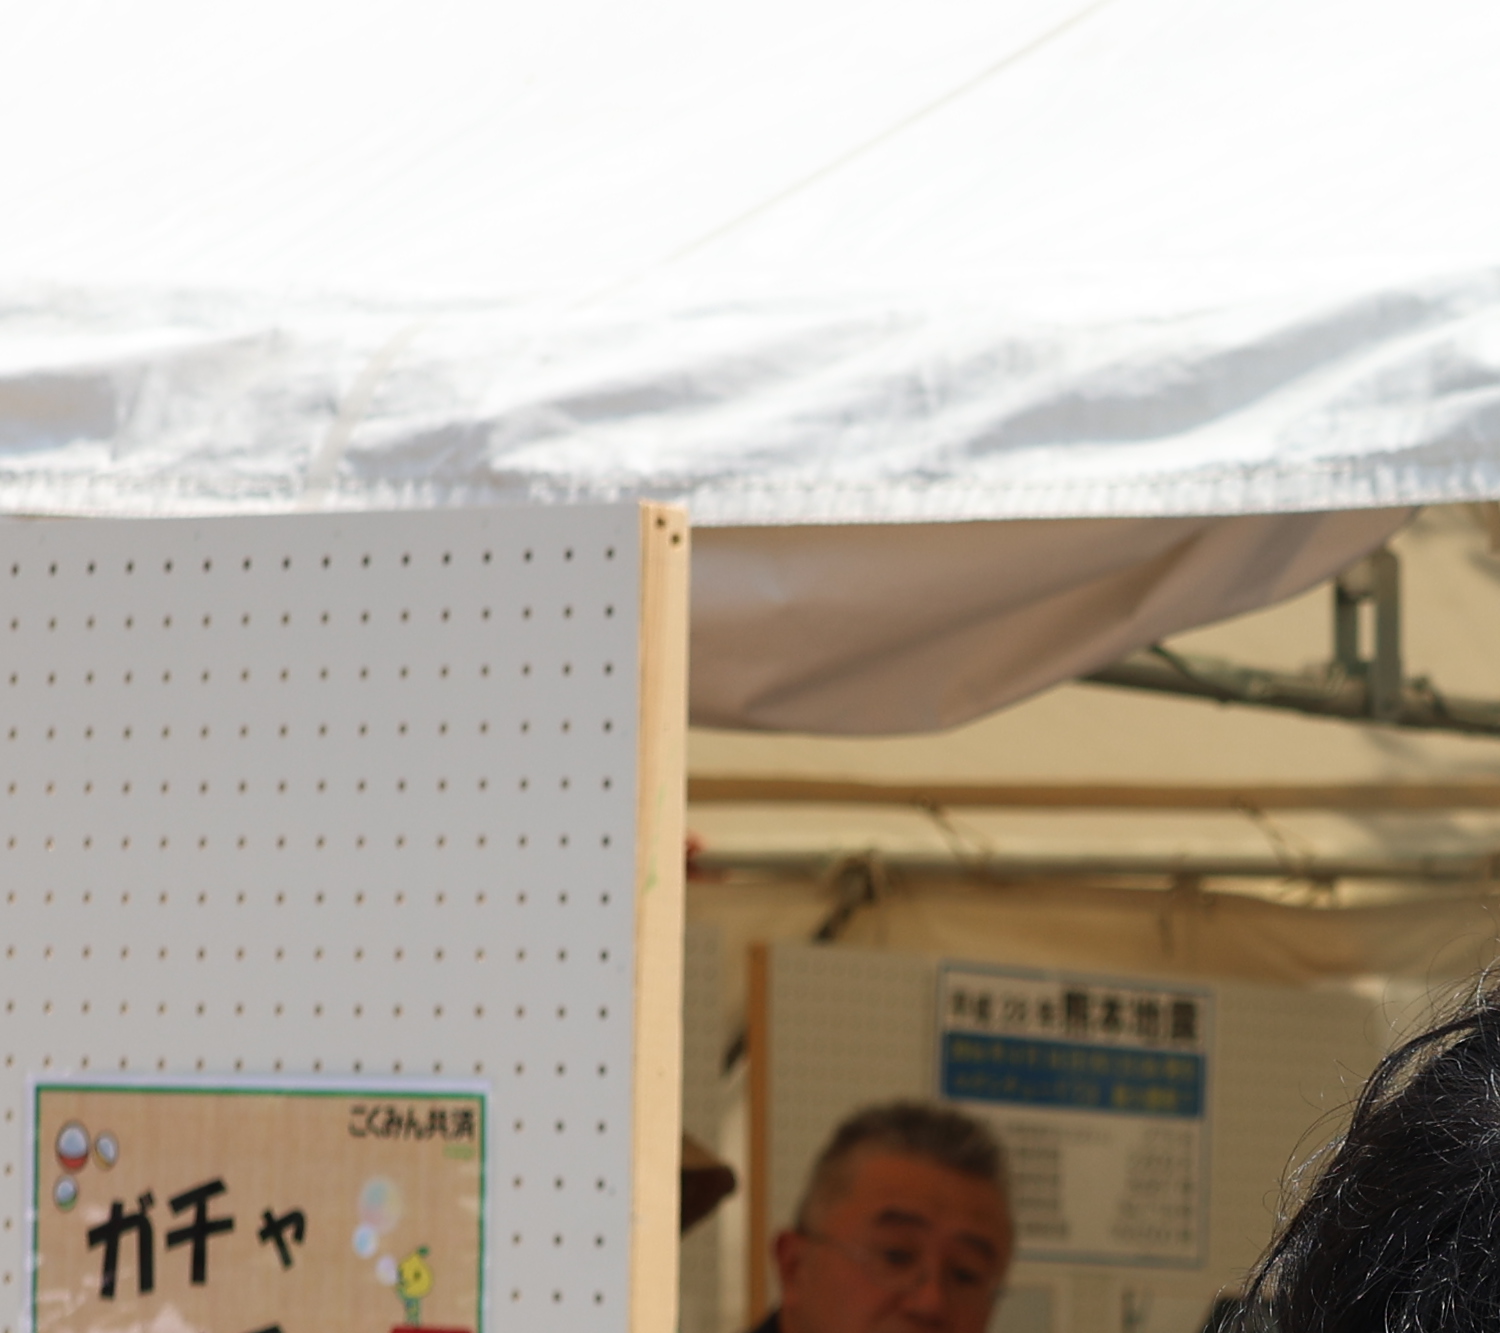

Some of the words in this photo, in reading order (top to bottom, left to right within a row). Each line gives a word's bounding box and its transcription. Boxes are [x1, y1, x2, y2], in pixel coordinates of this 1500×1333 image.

[348, 1105, 476, 1140] こくみん共済
[87, 1176, 305, 1301] ガチャ
